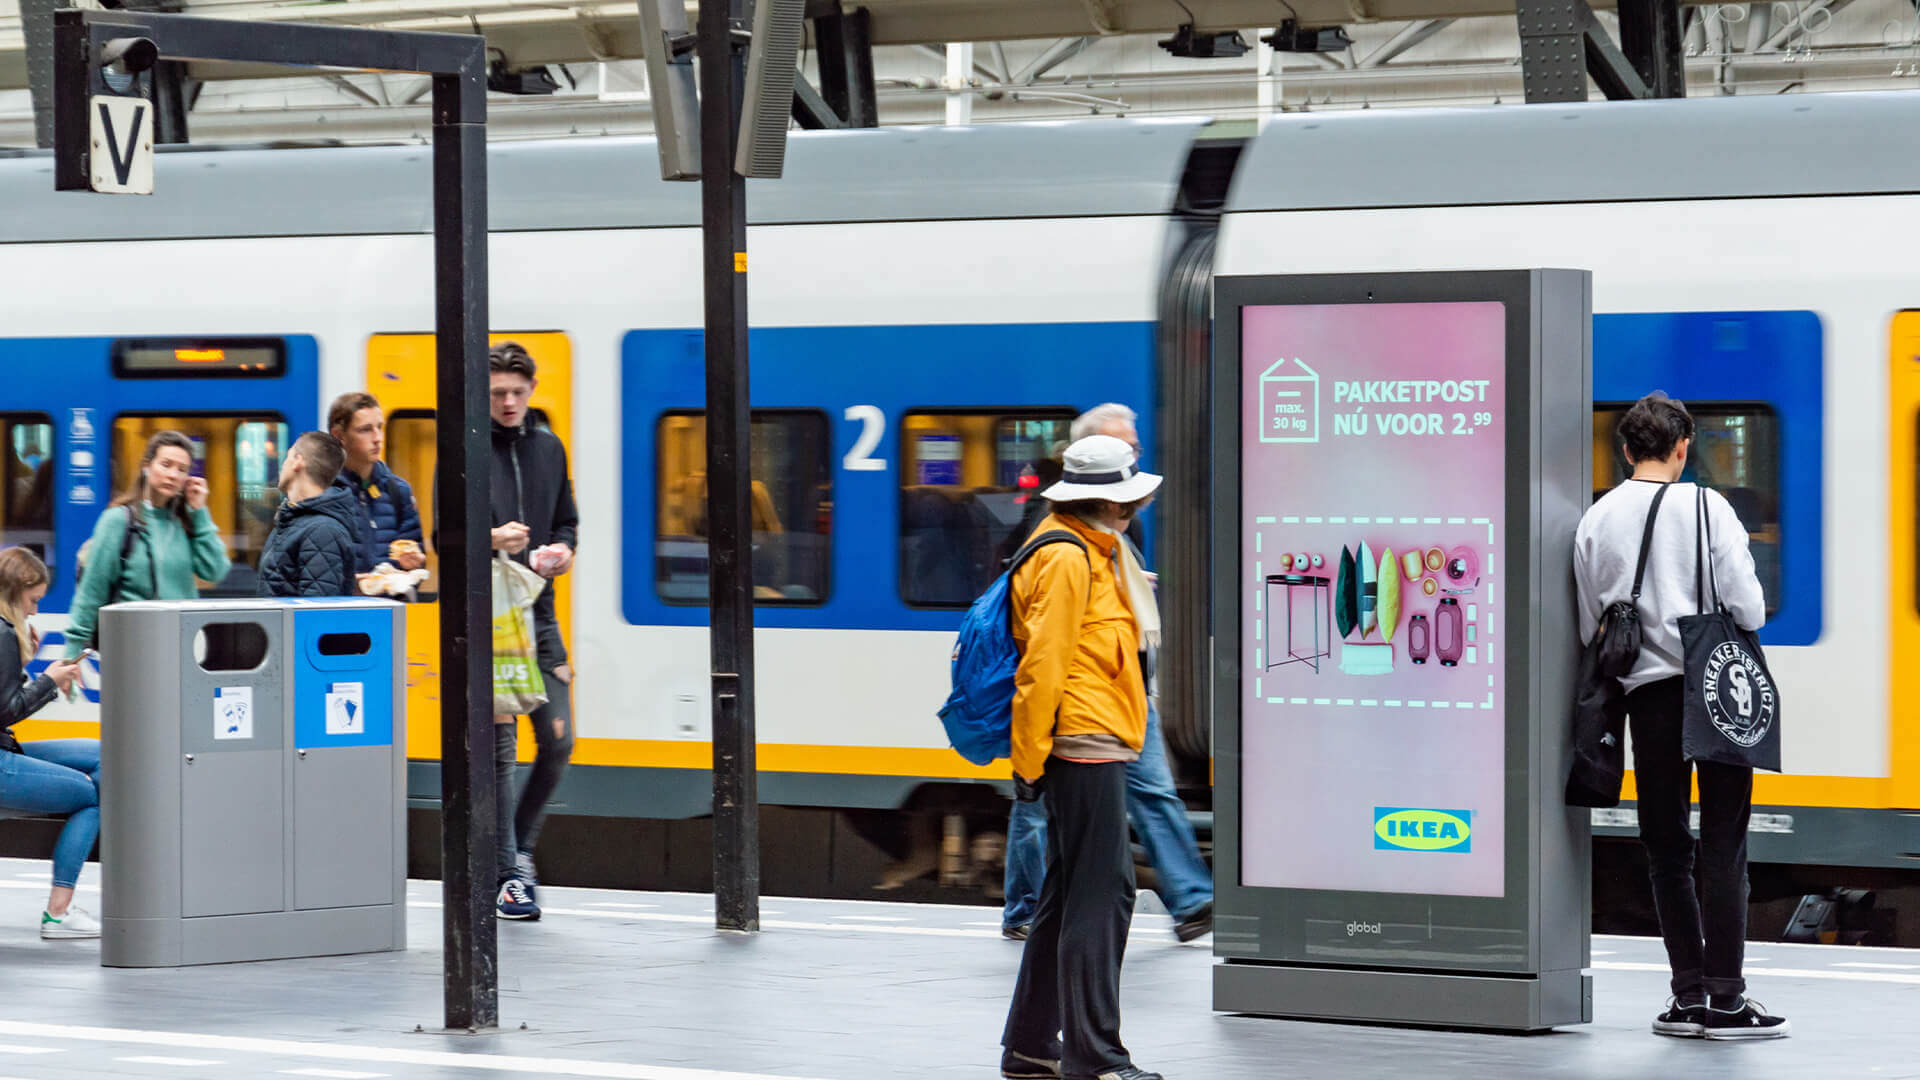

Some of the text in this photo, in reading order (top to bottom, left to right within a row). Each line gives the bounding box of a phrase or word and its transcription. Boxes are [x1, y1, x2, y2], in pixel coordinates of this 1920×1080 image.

[98, 103, 145, 186] V
[1334, 379, 1491, 403] PAKKETPOST
[1275, 403, 1305, 414] max.
[1273, 416, 1307, 432] 30 kg
[1334, 406, 1369, 436] NÚ
[1375, 413, 1445, 436] VOOR
[843, 404, 887, 471] 2
[493, 663, 529, 681] LUS
[1387, 820, 1460, 839] IKEA
[1346, 920, 1381, 937] global
